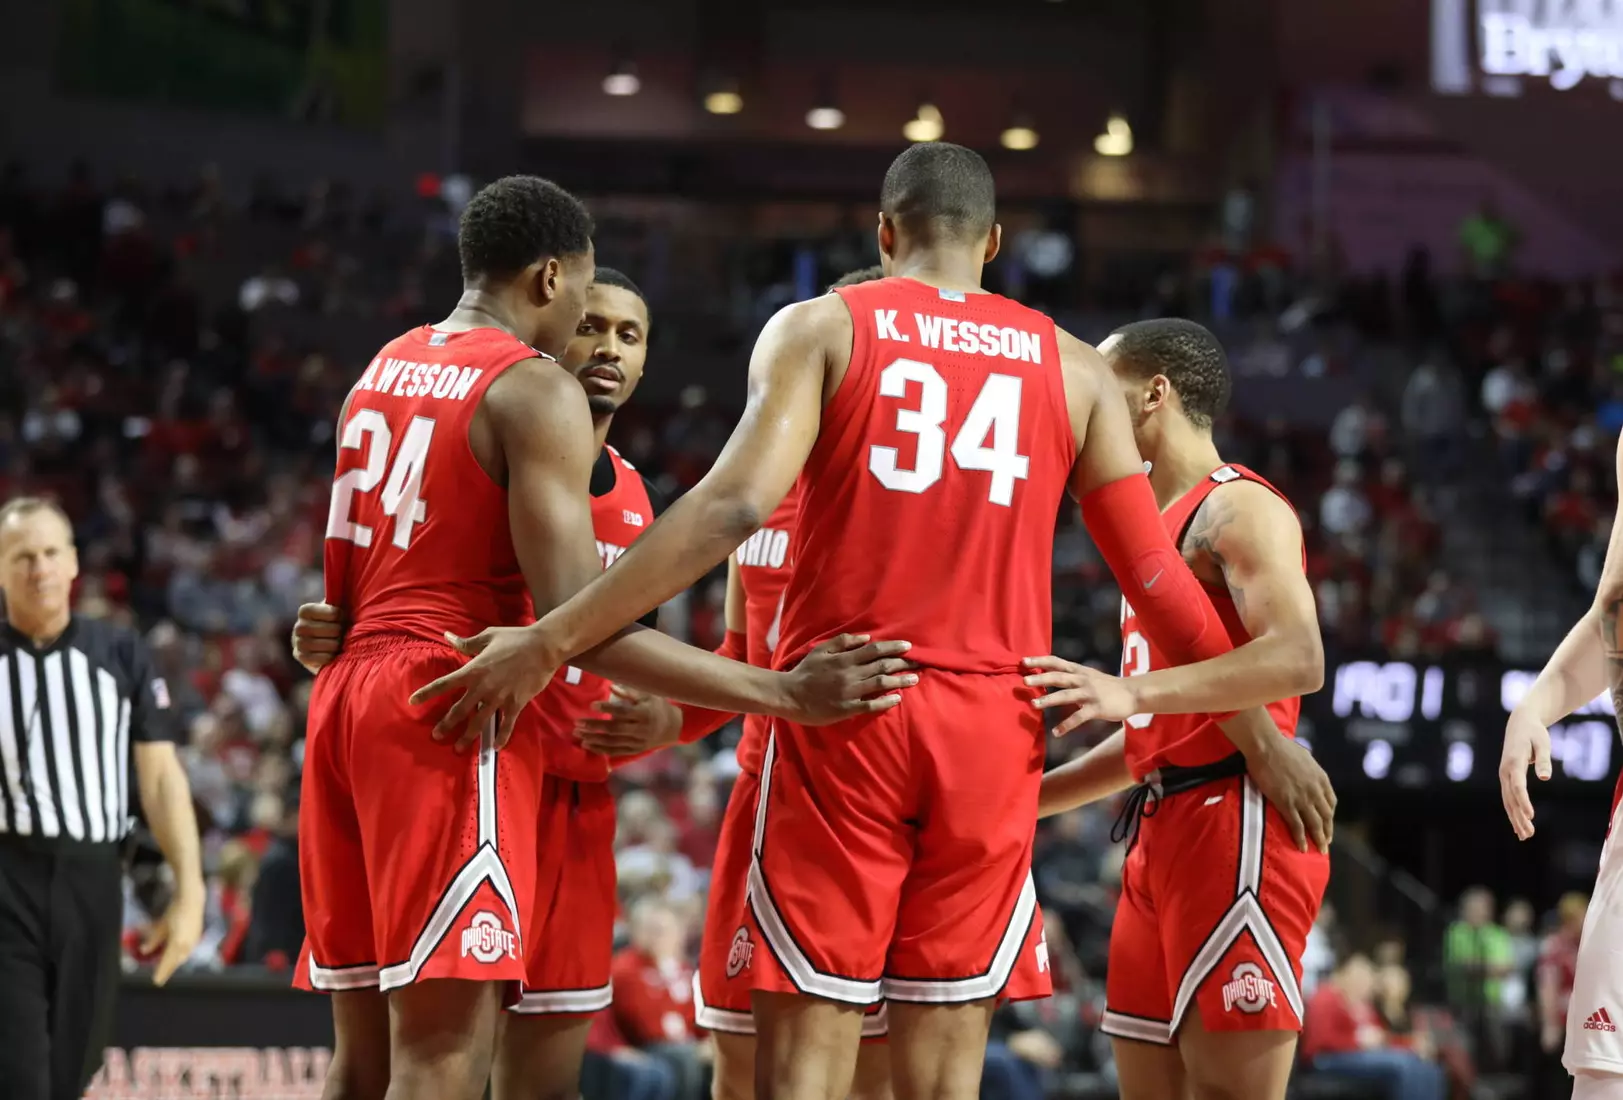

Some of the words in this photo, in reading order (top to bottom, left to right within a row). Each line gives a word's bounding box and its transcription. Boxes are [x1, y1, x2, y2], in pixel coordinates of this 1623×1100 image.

[874, 309, 910, 342] K.
[914, 312, 1042, 364] WESSON
[375, 358, 483, 400] WESSON
[868, 358, 1029, 507] 34
[325, 408, 436, 550] 24
[1583, 1022, 1616, 1032] adidas
